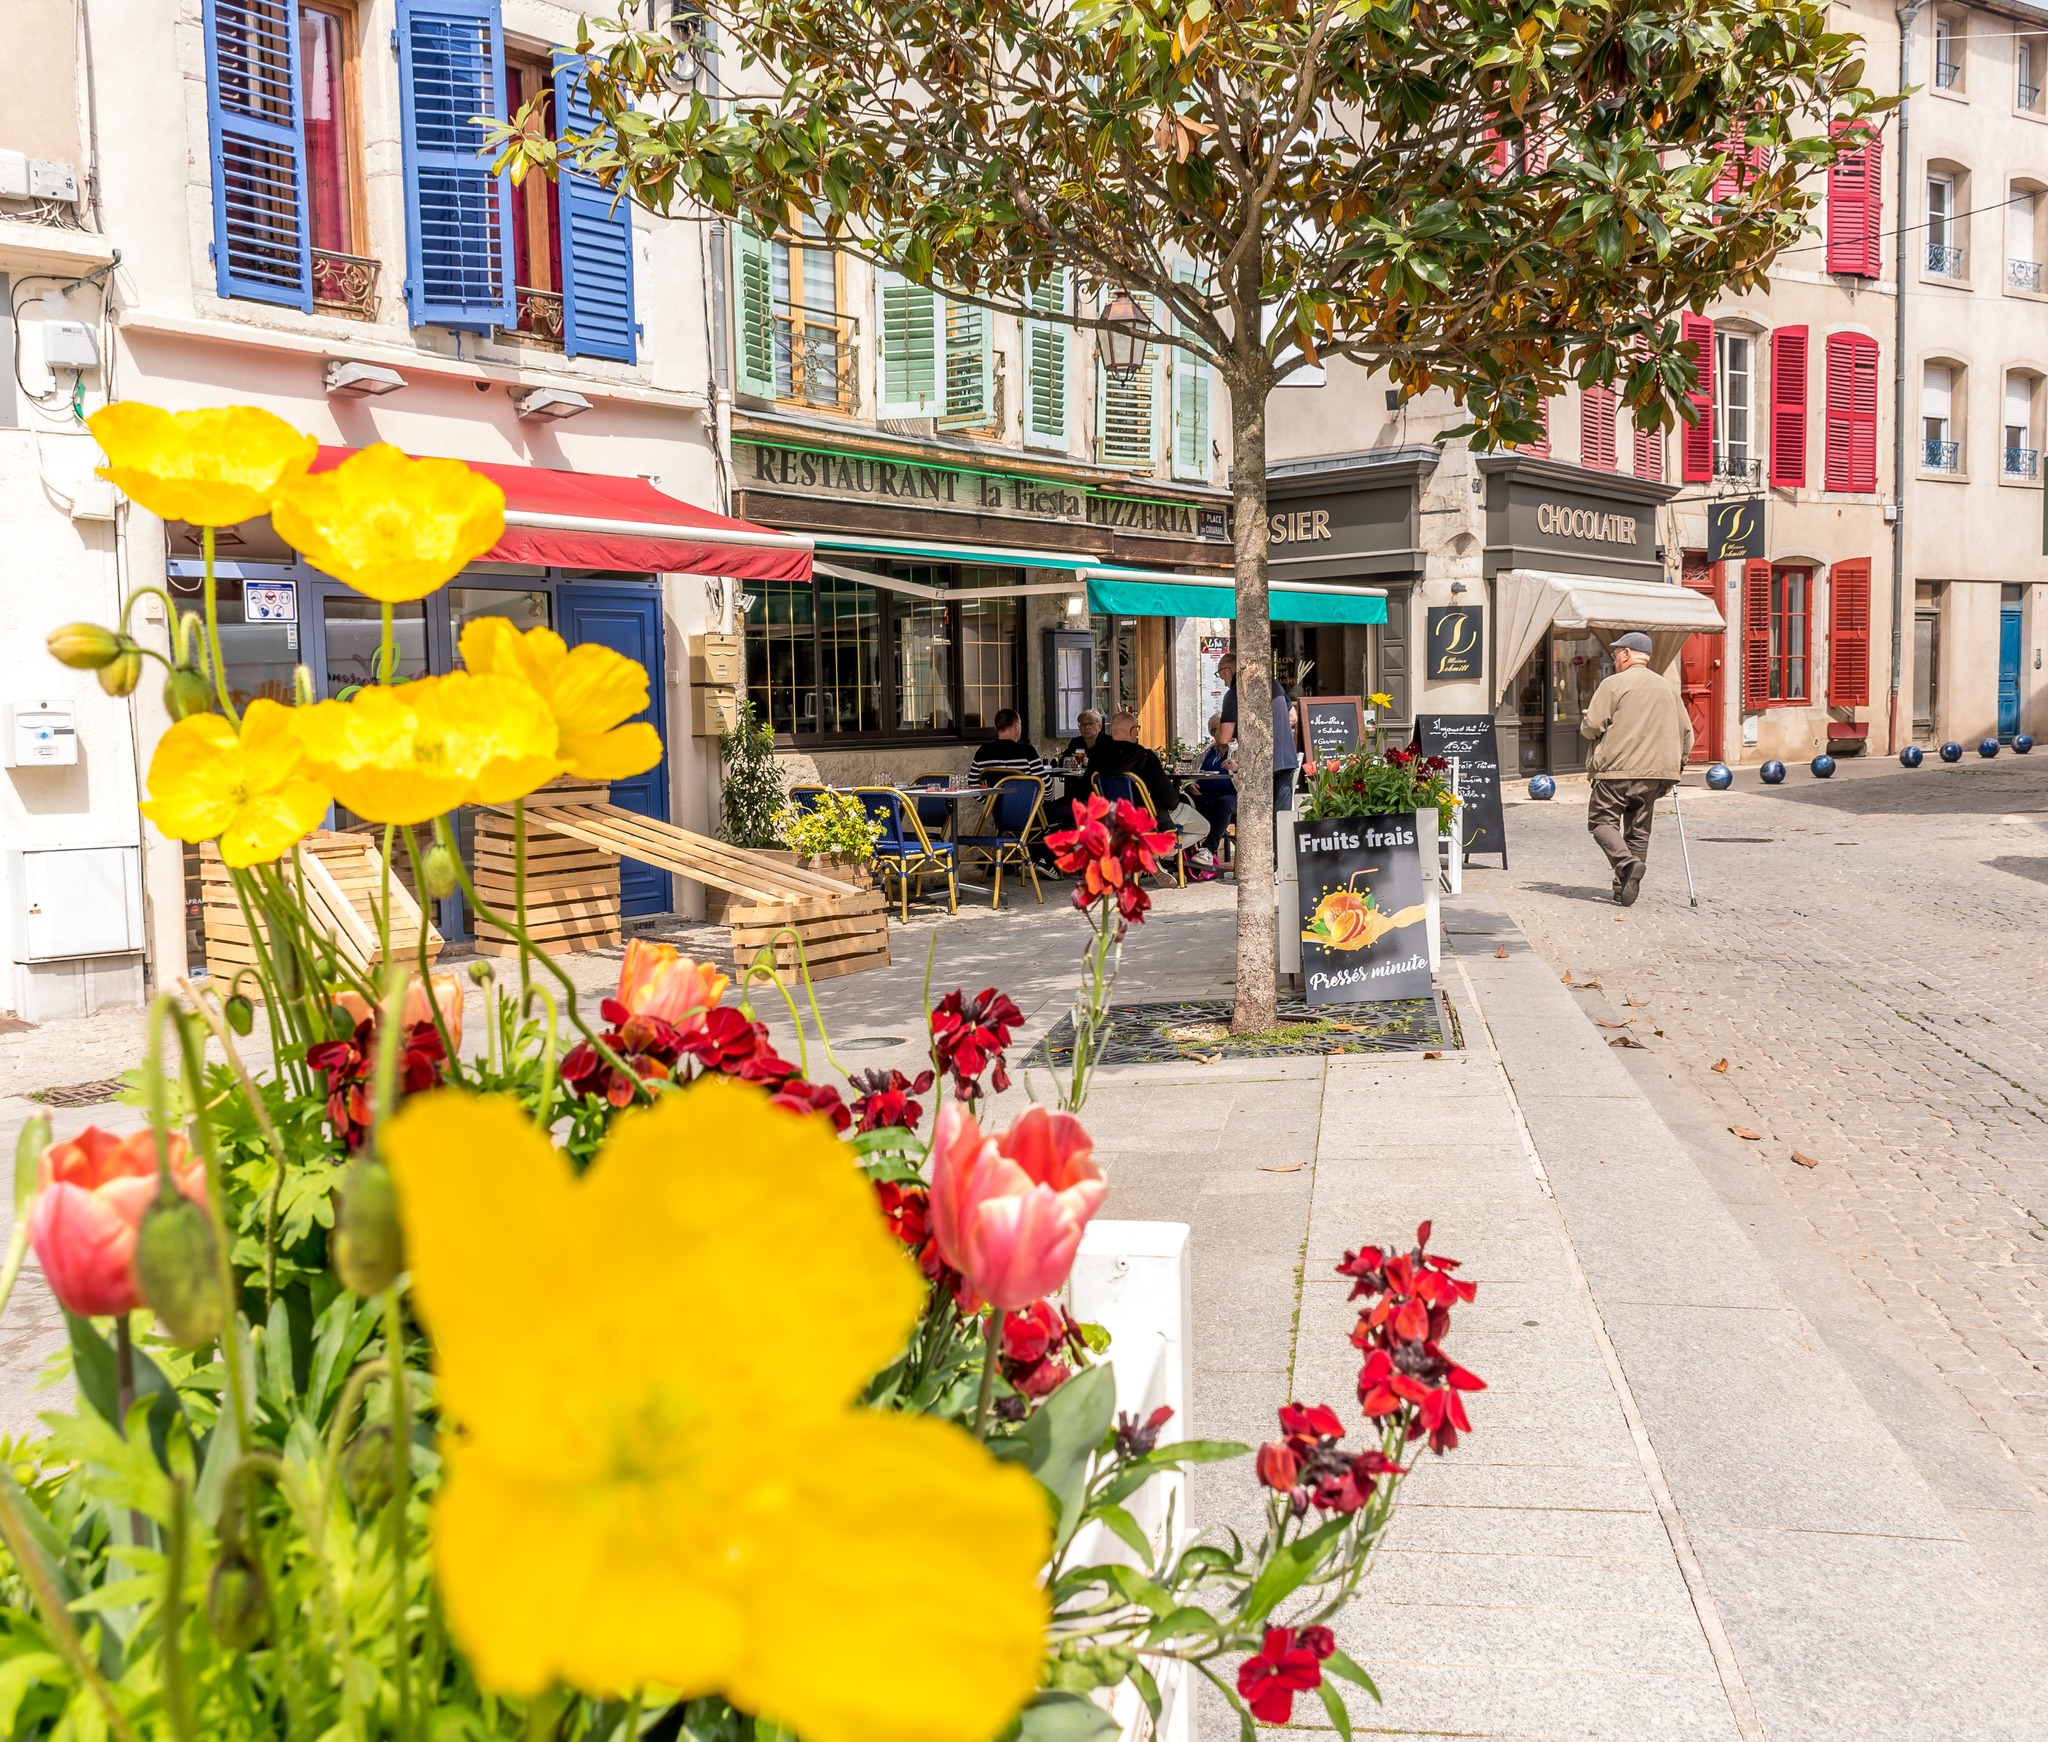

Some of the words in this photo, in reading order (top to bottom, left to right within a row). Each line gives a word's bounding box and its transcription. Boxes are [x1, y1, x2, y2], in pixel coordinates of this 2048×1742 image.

[752, 445, 960, 502] RESTAURANT
[976, 475, 1003, 508] la
[1011, 479, 1081, 516] Fiesta
[1085, 497, 1194, 534] PIZZERIA
[1206, 513, 1223, 524] PLACE
[1537, 503, 1637, 545] CHOCOLATIER
[1718, 542, 1748, 560] Schmitt
[1436, 655, 1470, 674] Schmitt
[1299, 830, 1360, 853] Fruits
[1365, 826, 1415, 848] frais
[1309, 966, 1369, 991] Pressés
[1370, 953, 1429, 979] minute
